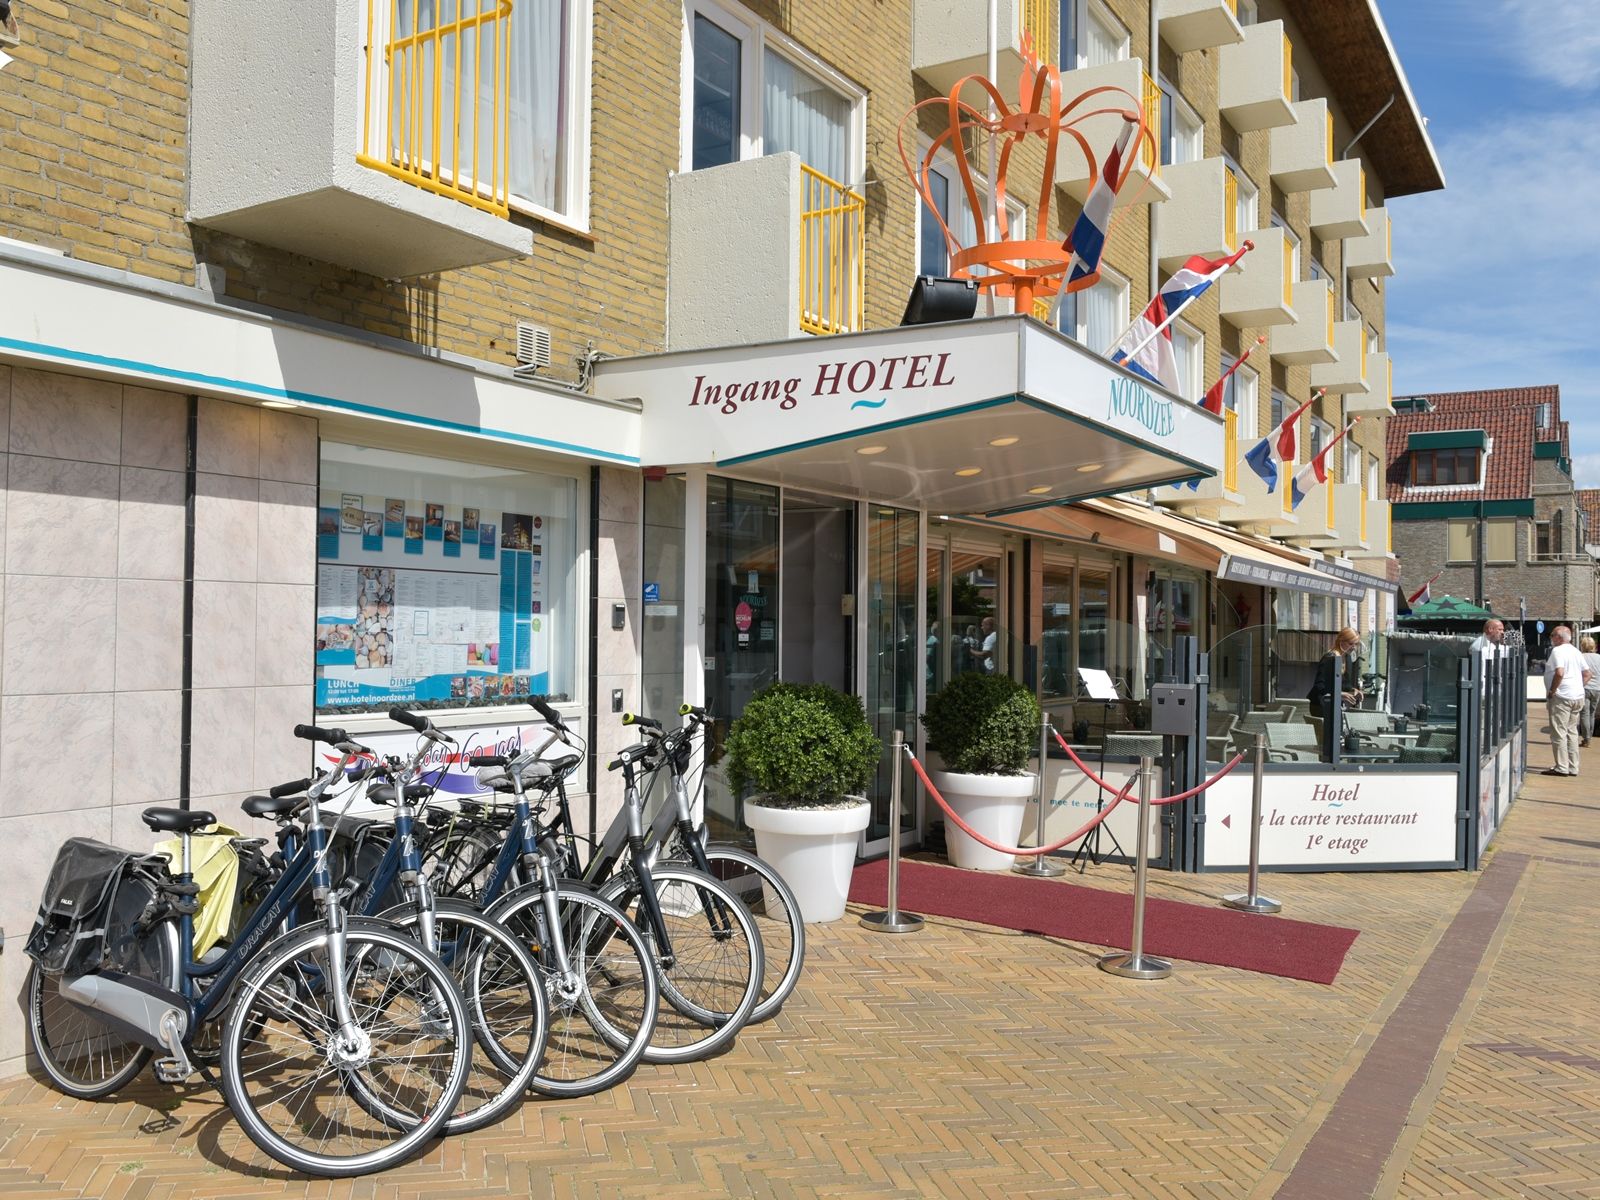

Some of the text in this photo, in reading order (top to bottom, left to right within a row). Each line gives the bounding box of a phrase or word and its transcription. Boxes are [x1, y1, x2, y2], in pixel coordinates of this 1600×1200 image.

[689, 353, 956, 415] Ingang HOTEL
[1107, 377, 1175, 437] NOORDZEE
[327, 677, 416, 689] LUNCH DINER
[327, 692, 416, 704] www.hotelnoordzee.nl
[1311, 783, 1361, 802] Hotel
[1269, 809, 1285, 826] la
[1290, 812, 1331, 826] carte
[1335, 812, 1419, 826] restaurant
[1305, 834, 1369, 854] 1e etage
